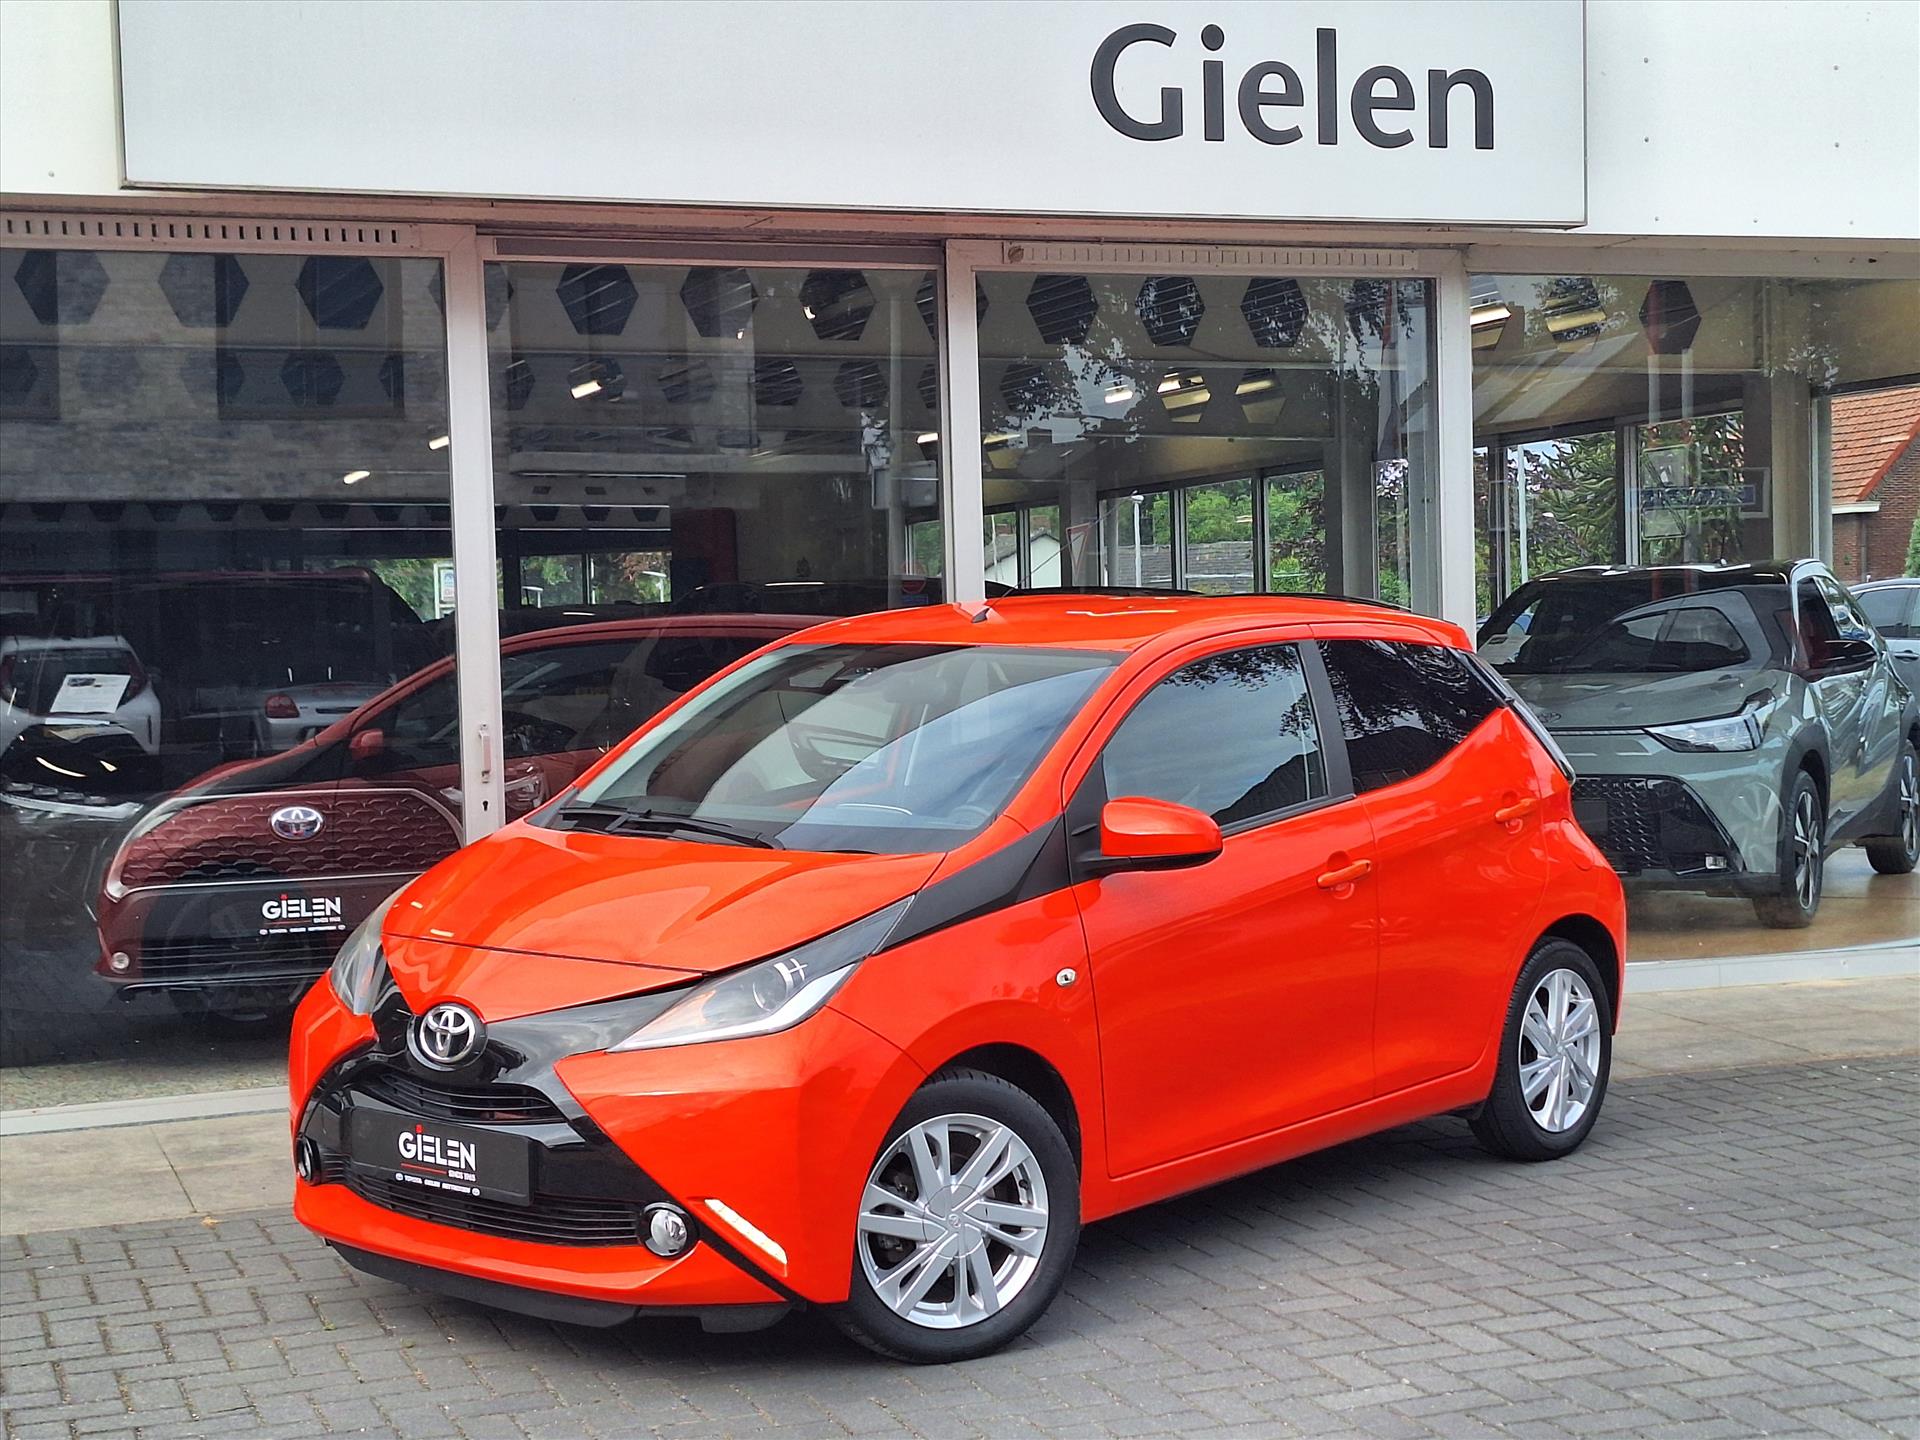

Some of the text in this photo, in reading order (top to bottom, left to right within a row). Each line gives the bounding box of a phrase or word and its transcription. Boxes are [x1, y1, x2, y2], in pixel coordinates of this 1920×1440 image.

[1090, 22, 1494, 150] Gielen
[261, 893, 341, 919] GIELEN
[398, 1124, 476, 1171] GIELEN
